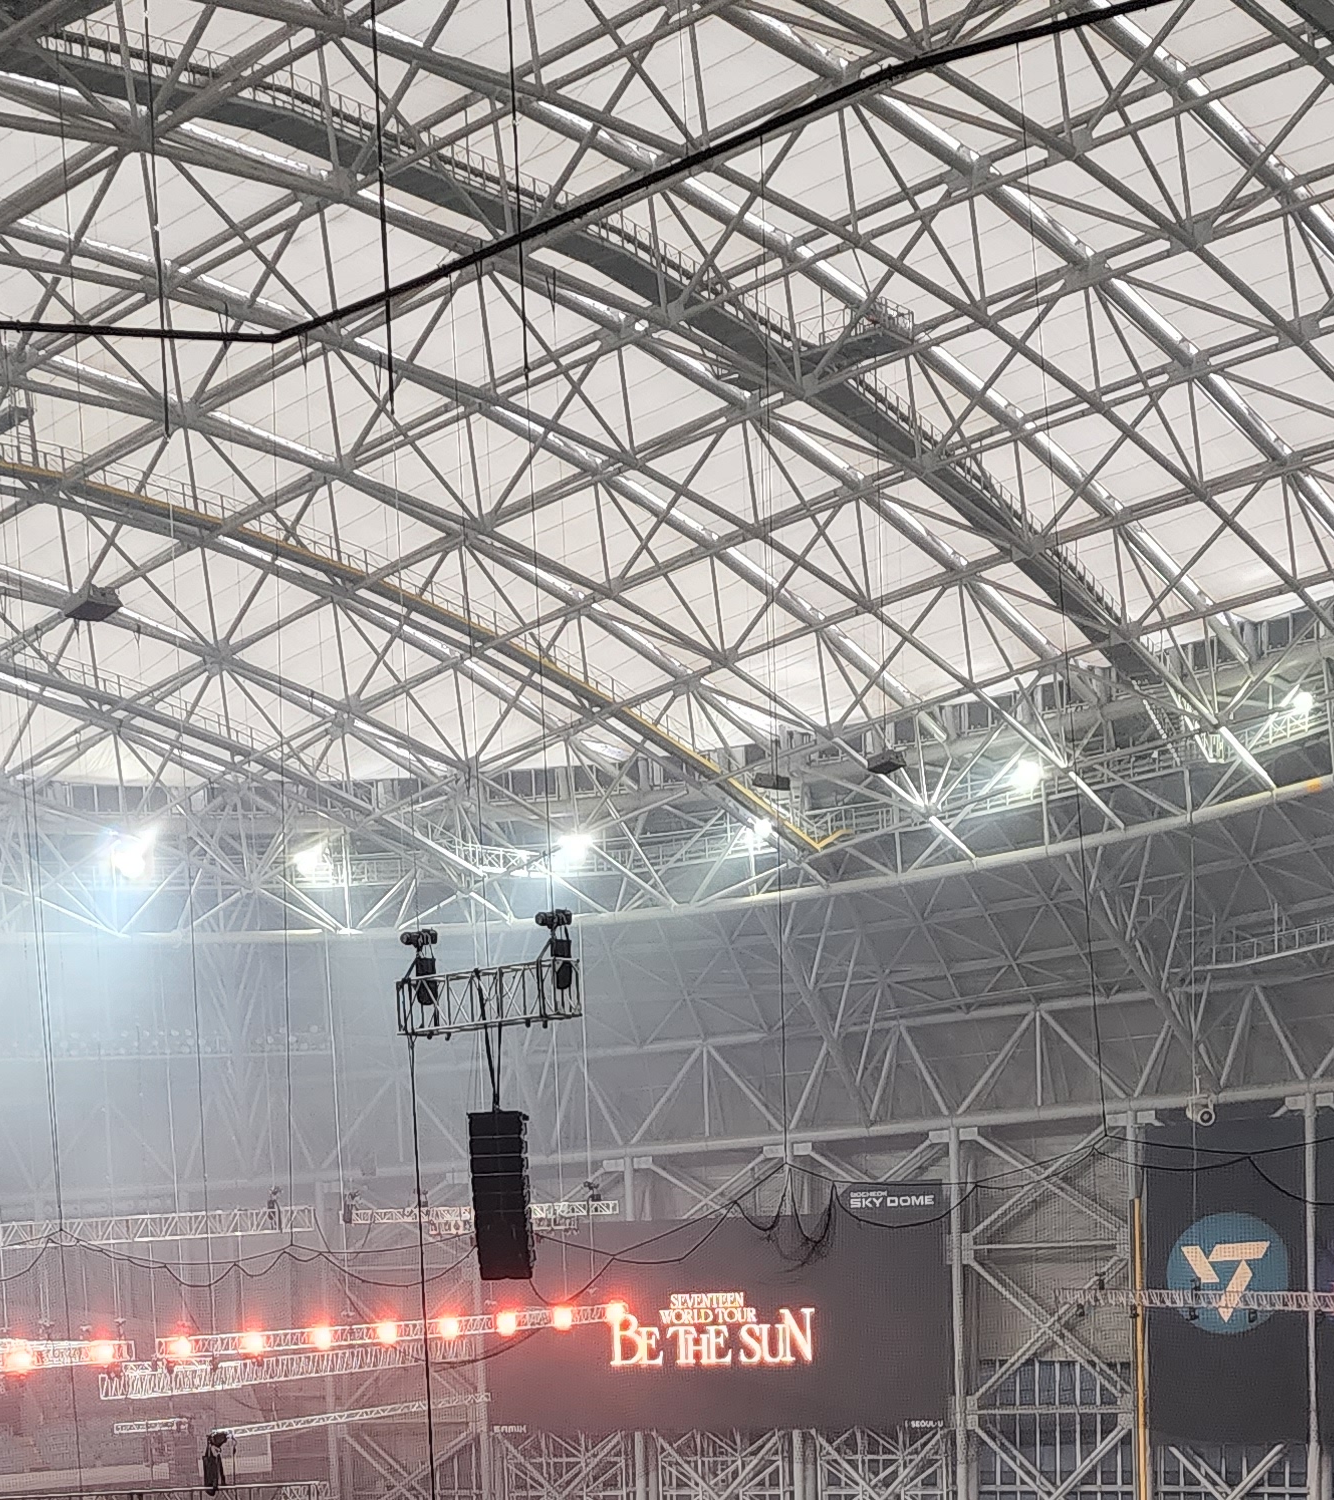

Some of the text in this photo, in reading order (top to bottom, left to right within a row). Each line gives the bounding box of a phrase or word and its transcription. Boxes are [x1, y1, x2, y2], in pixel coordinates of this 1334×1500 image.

[850, 1194, 935, 1209] SKY DOME
[670, 1292, 744, 1309] SEVENTEEN
[659, 1307, 757, 1324] WORLD TOUR
[610, 1307, 815, 1365] BE THE SUN
